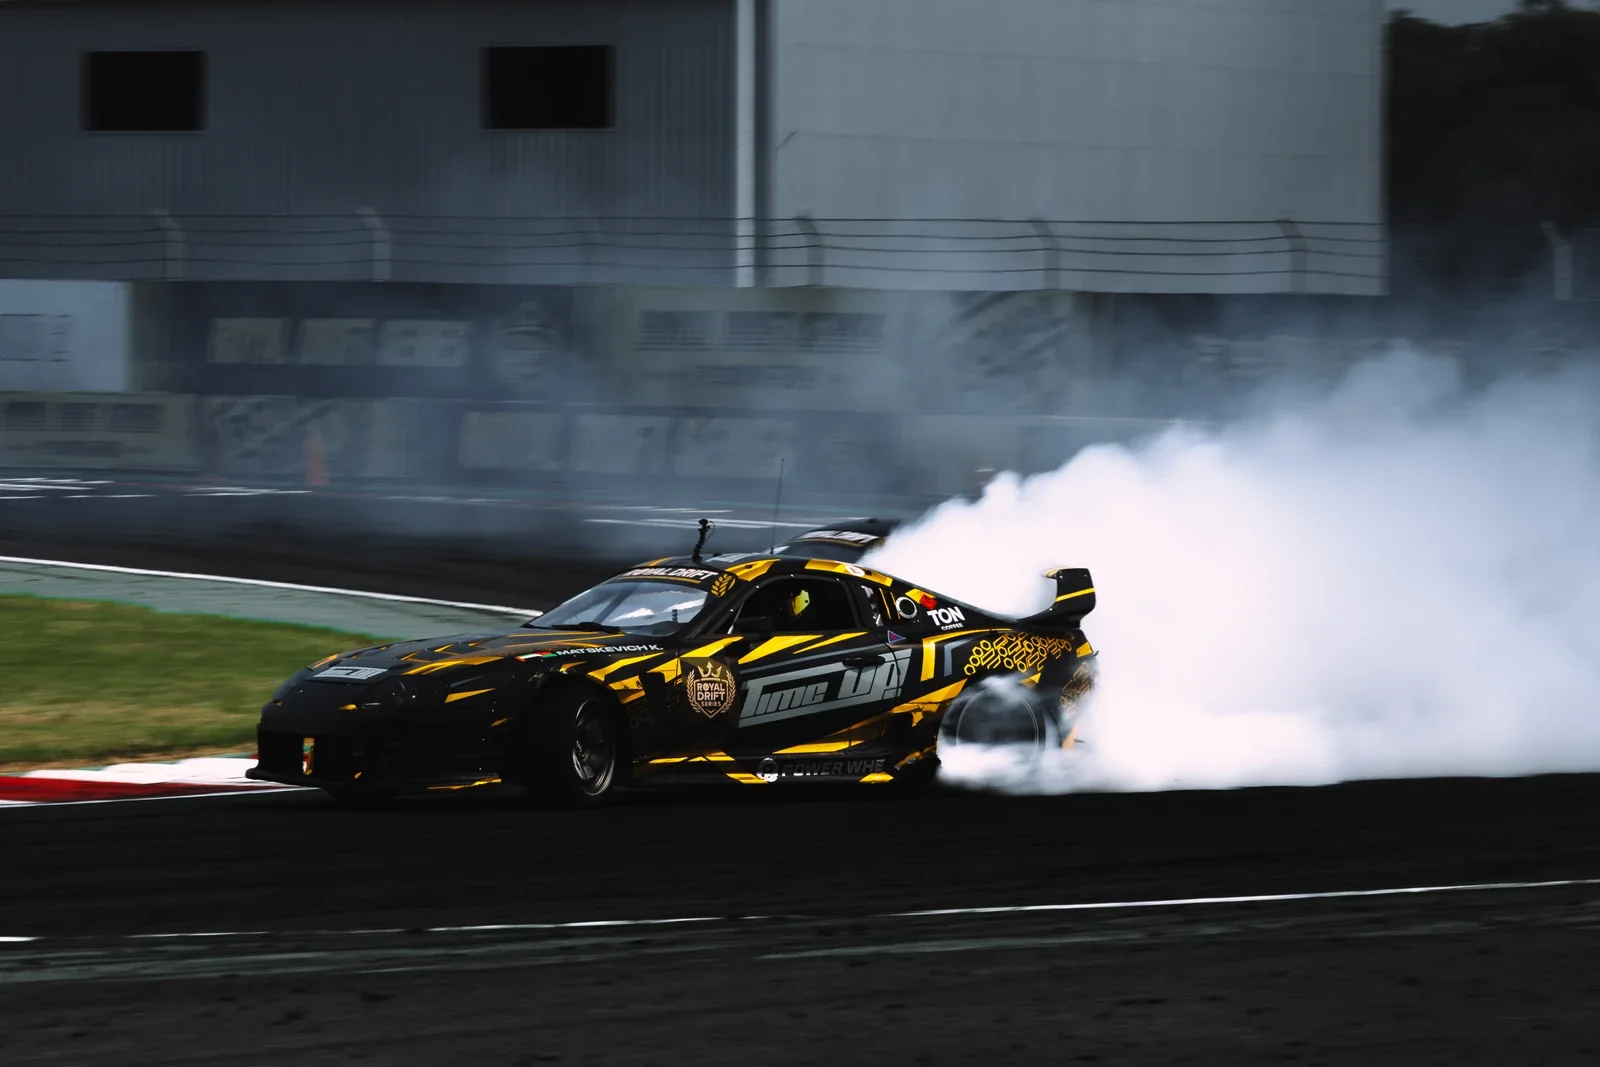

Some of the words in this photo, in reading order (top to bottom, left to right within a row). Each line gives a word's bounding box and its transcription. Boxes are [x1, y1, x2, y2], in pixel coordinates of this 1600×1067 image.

[669, 568, 719, 580] DRIFT
[927, 606, 965, 626] TON
[556, 644, 648, 656] MATSKEVICH
[697, 683, 725, 691] ROYAL
[697, 692, 725, 700] DRIFT
[782, 762, 844, 777] POWER
